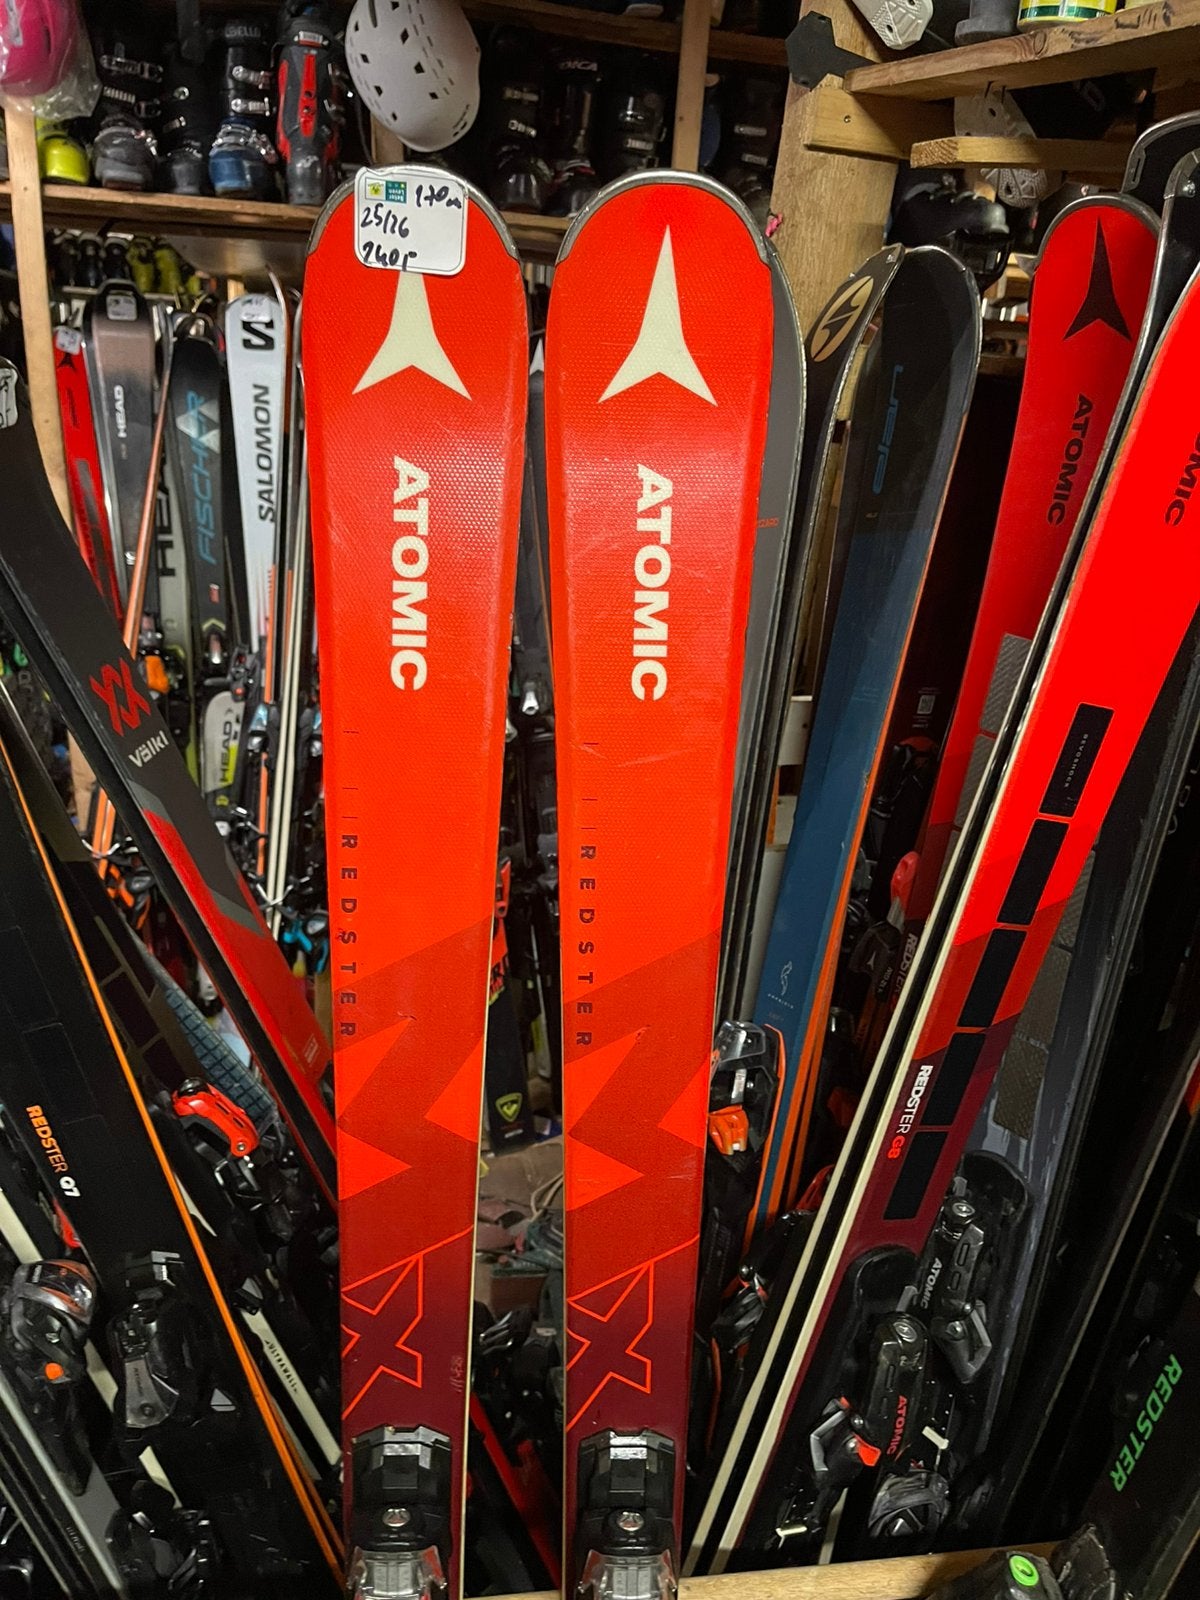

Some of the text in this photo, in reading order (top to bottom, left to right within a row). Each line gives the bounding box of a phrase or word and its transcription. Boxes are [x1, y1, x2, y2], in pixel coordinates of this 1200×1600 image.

[113, 384, 127, 438] HEAD
[252, 383, 275, 523] SALOMON
[1047, 392, 1094, 526] ATOMIC
[1164, 431, 1200, 527] MIC
[389, 455, 431, 692] ATOMIC
[630, 463, 674, 702] ATOMIC
[218, 720, 232, 784] HEAD
[340, 833, 358, 1037] REDSTER
[576, 844, 597, 1046] REDSTER
[25, 1104, 69, 1174] REDSTER
[896, 1064, 934, 1134] REDSTER
[919, 1256, 943, 1310] ATOMIC
[886, 1394, 908, 1456] ATOMIC
[1109, 1352, 1184, 1492] REDSTER
